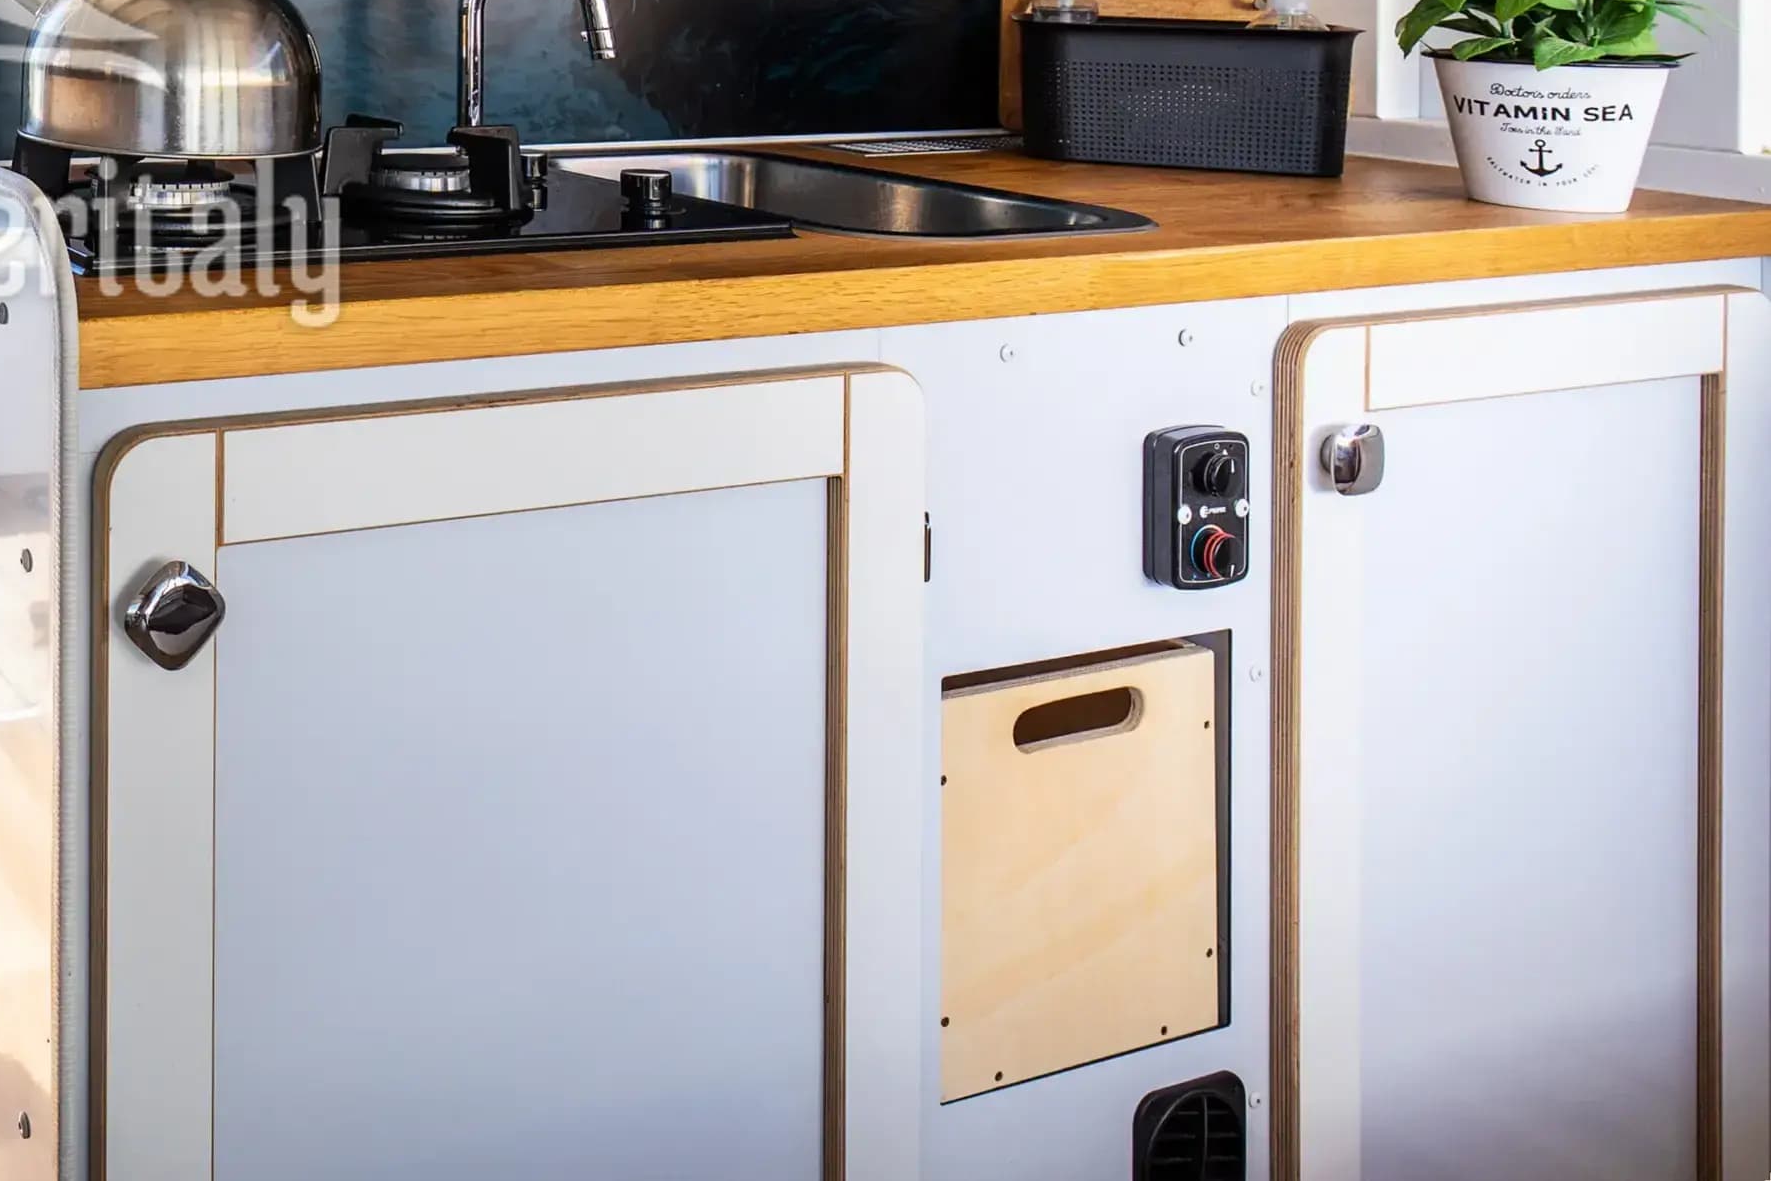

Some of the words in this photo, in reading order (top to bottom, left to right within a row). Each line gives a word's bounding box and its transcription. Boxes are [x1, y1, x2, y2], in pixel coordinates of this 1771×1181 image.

[1547, 87, 1591, 100] orders
[1453, 94, 1570, 122] VITAMIN
[1583, 103, 1633, 122] SEA
